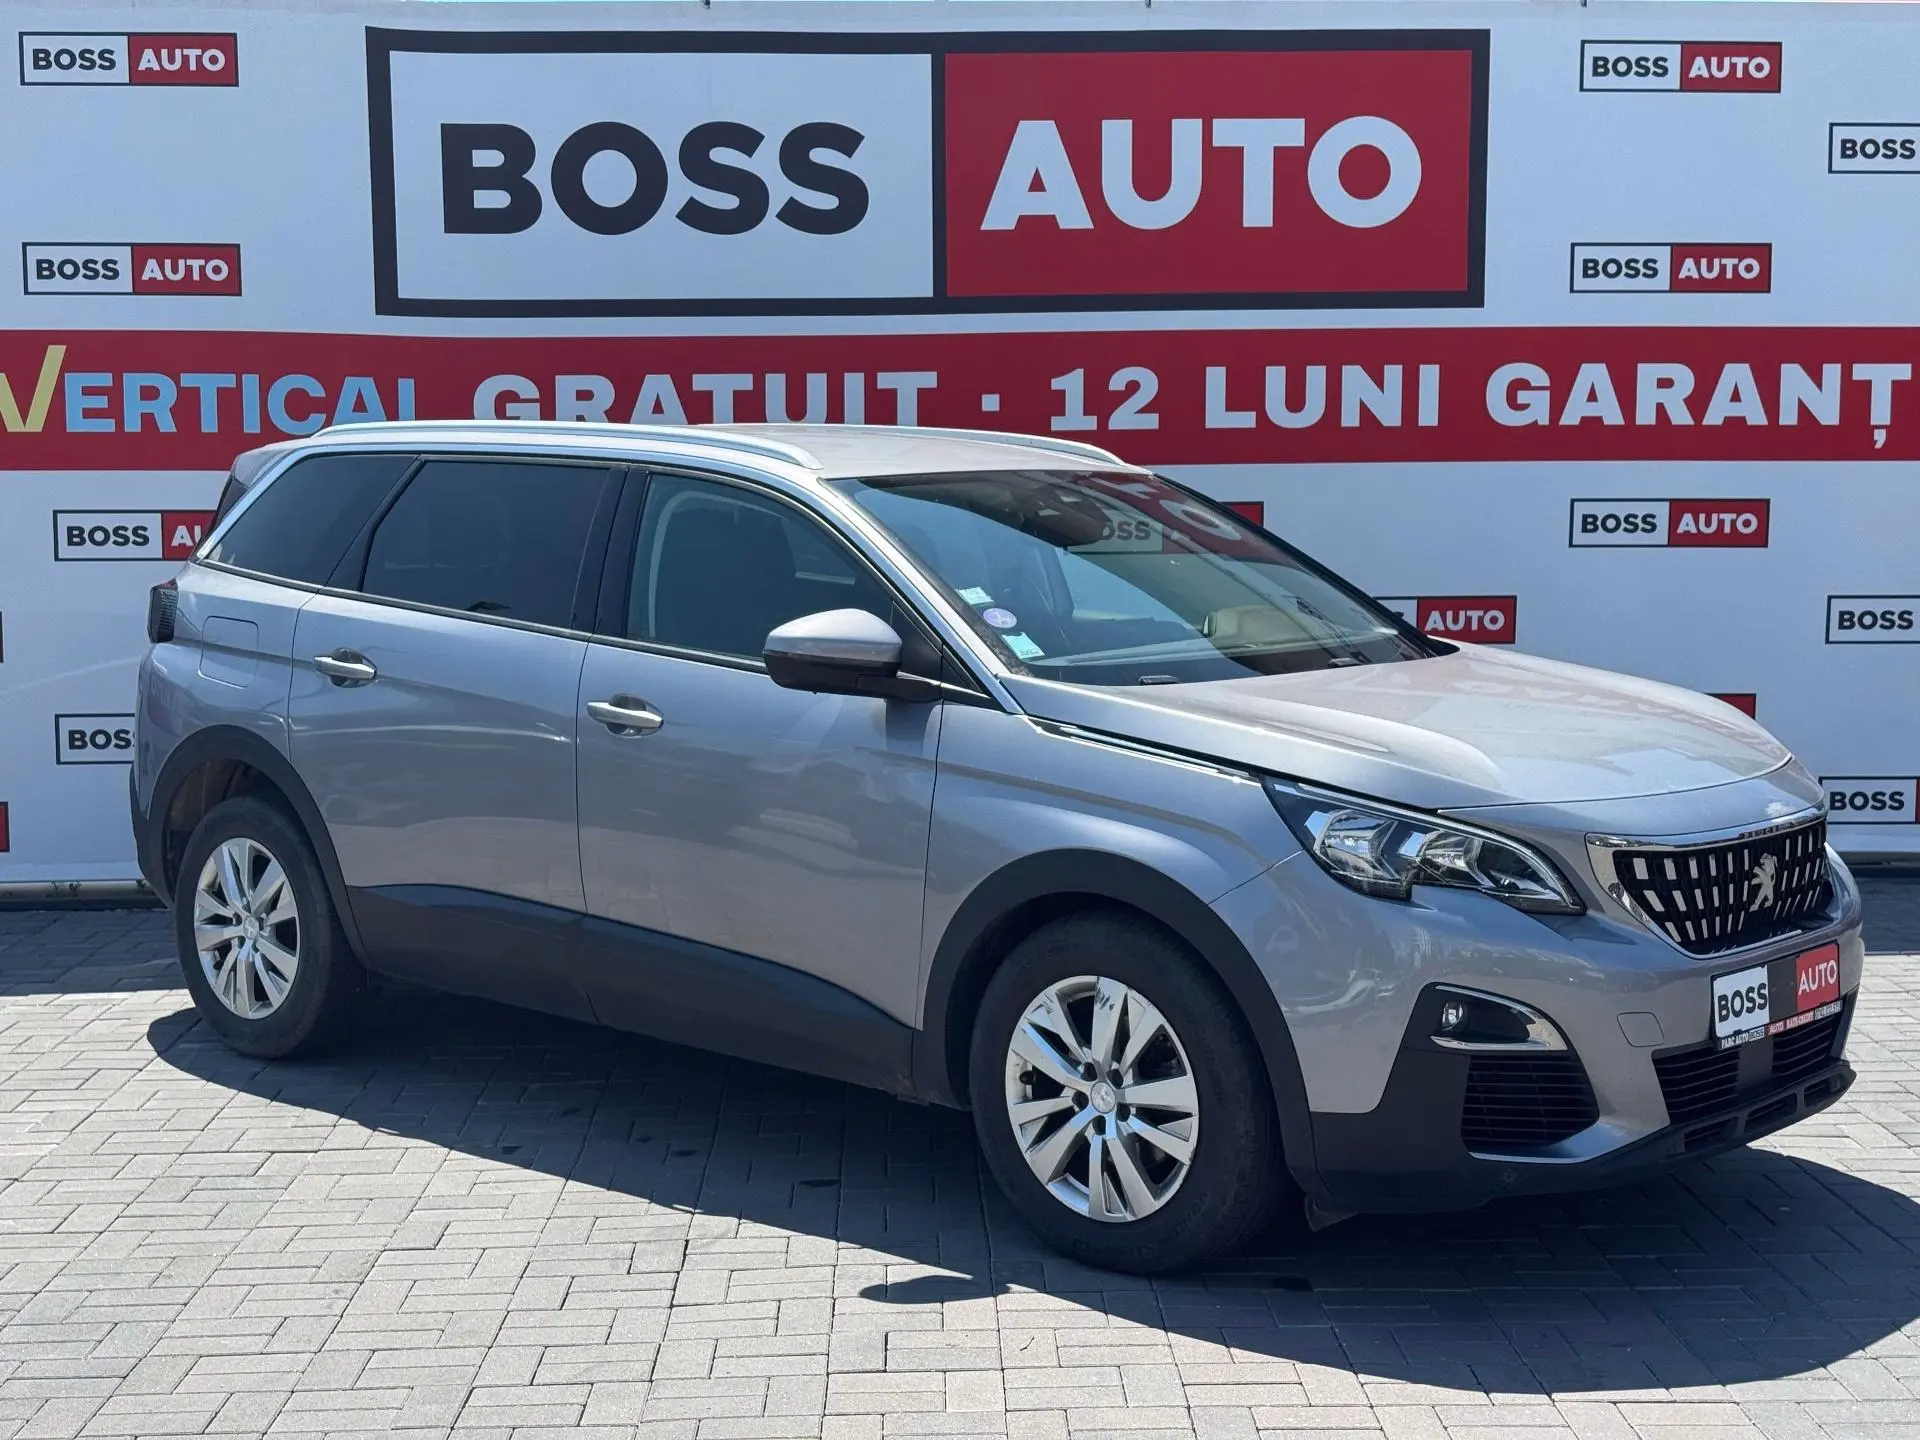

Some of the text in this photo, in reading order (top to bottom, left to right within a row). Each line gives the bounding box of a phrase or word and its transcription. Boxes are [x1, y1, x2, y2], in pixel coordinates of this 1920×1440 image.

[32, 48, 226, 72] BOSS AUTO
[1591, 56, 1770, 79] BOSS AUTO
[1840, 138, 1916, 160] BOSS
[441, 116, 1422, 235] BOSS AUTO
[36, 258, 229, 282] BOSS AUTO
[1581, 258, 1761, 280] BOSS AUTO
[473, 371, 937, 426] GRATUIT
[1050, 366, 1160, 431] 12
[1205, 364, 1440, 429] LUNI
[1580, 513, 1758, 535] BOSS AUTO
[66, 525, 150, 547] BOSS
[1424, 609, 1506, 632] AUTO
[1837, 610, 1914, 631] BOSS
[68, 729, 135, 750] BOS
[1829, 790, 1905, 812] BOSS
[1717, 982, 1768, 1023] BOSS
[1798, 959, 1837, 997] AUTO
